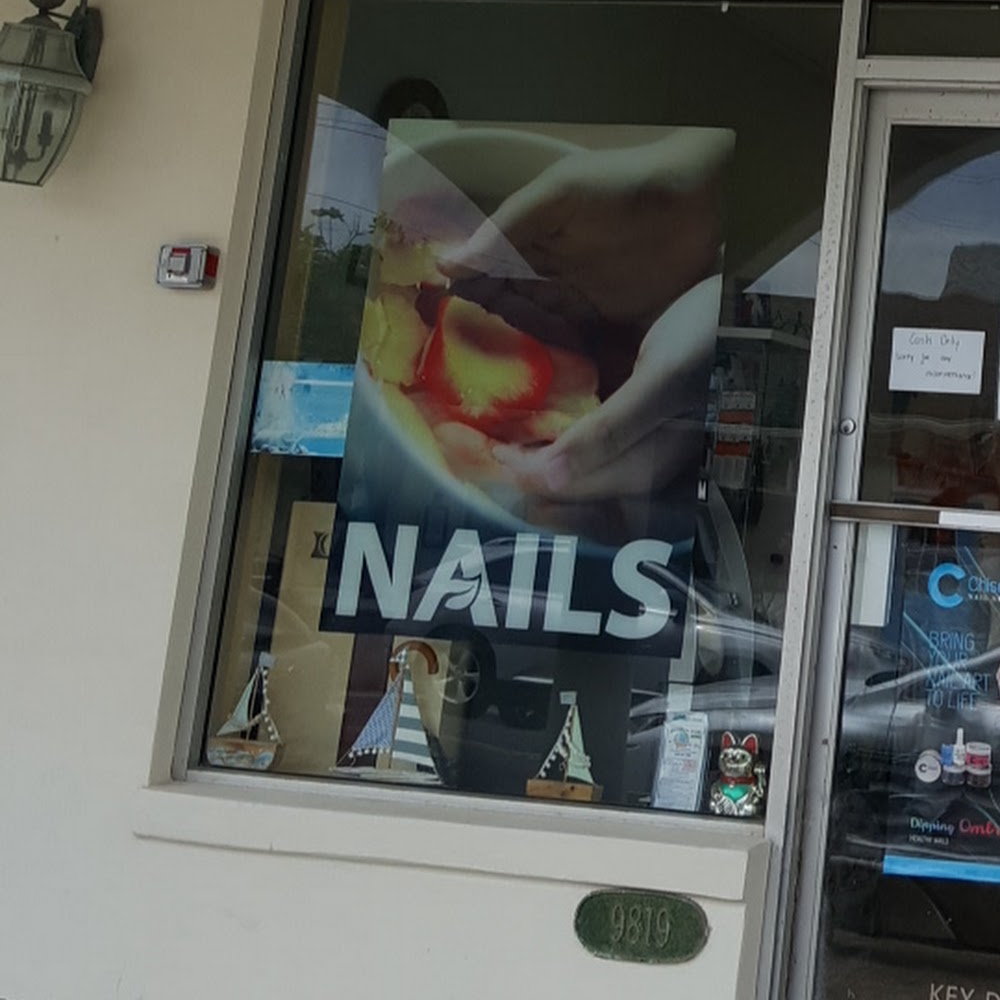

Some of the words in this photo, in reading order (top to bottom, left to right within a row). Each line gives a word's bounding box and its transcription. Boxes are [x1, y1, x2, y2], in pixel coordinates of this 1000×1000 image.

[334, 521, 674, 640] NAILS
[928, 630, 975, 651] BRING
[926, 690, 944, 708] TO
[948, 691, 978, 711] LIFE
[909, 816, 955, 837] Dipping
[930, 983, 975, 1000] KEY
